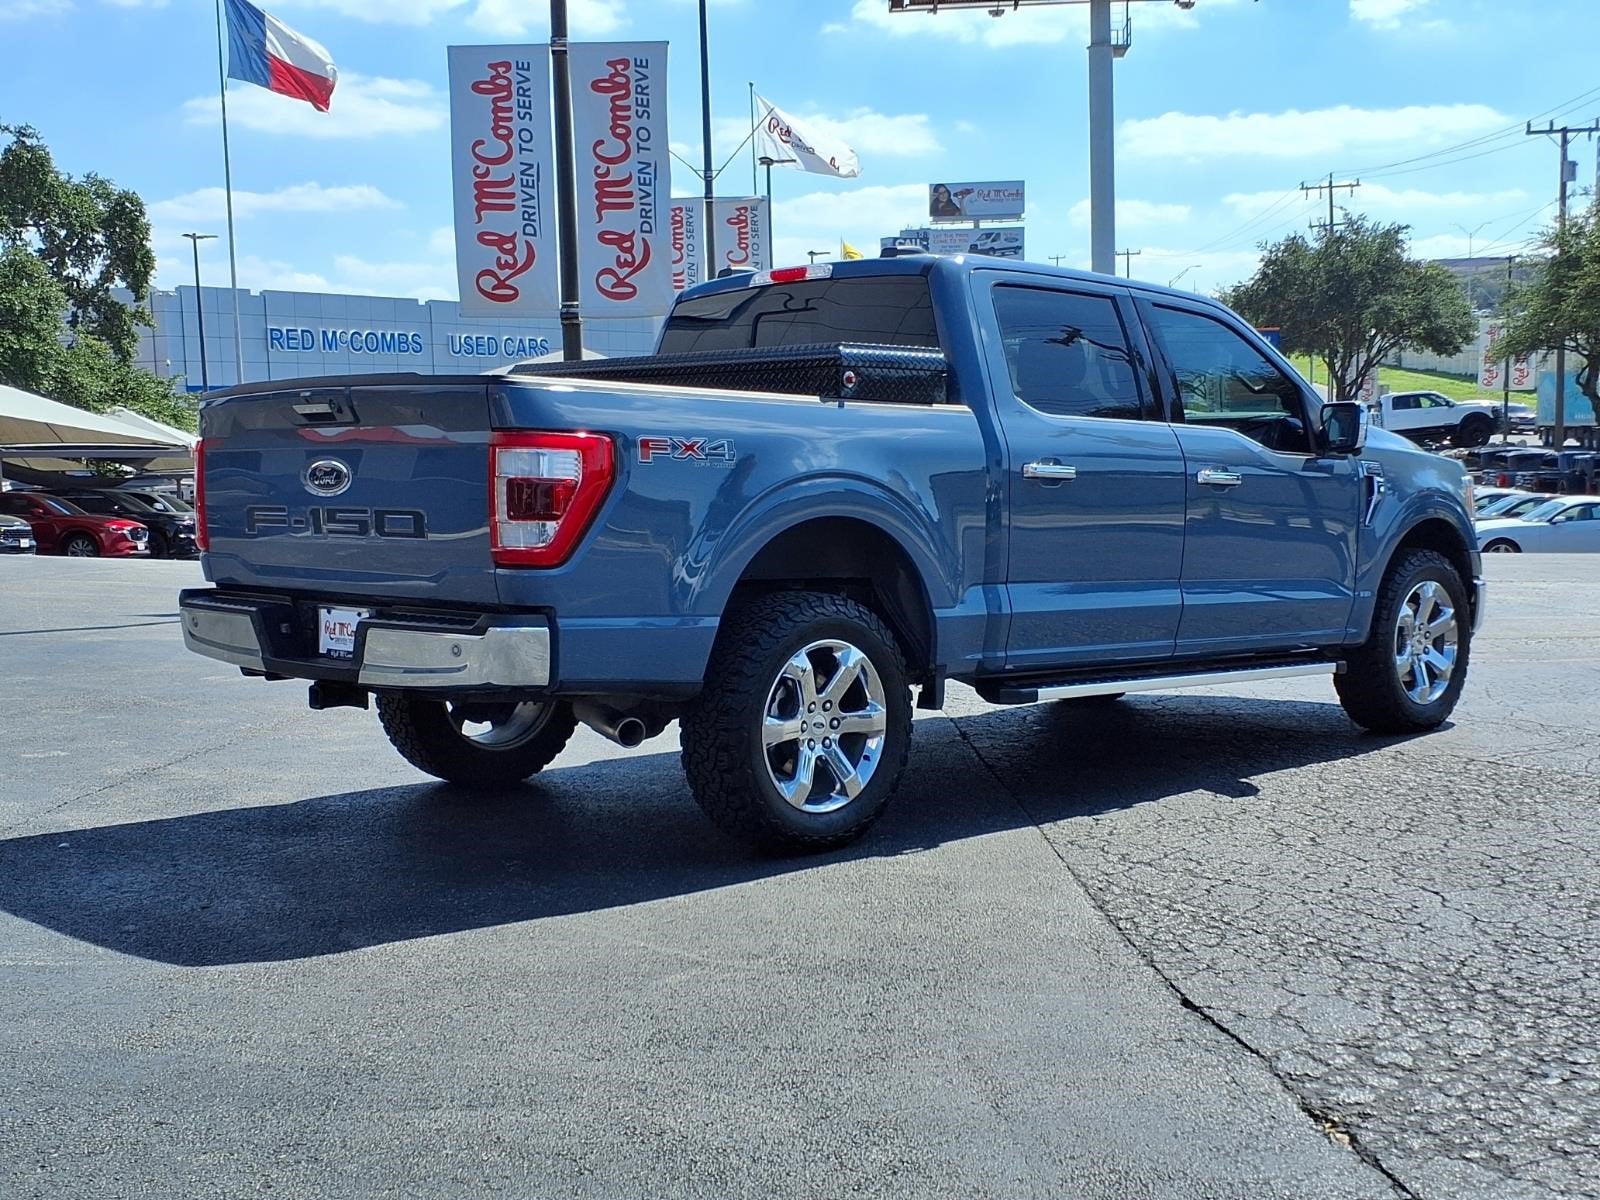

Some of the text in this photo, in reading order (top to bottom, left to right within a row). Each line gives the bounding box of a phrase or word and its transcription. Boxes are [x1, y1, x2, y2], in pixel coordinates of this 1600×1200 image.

[515, 60, 541, 237] DRIVEN TO SERVE
[634, 57, 657, 235] DRIVEN TO SERVE
[471, 61, 535, 303] Red McCombs
[590, 57, 651, 301] Red McCombs
[685, 206, 695, 240] SERVE
[750, 205, 759, 239] SERVE
[686, 243, 696, 258] TO
[752, 242, 760, 257] TO
[269, 327, 315, 351] RED
[450, 334, 550, 357] USED CARS
[1512, 367, 1530, 386] Red
[637, 436, 736, 464] FX4
[313, 466, 338, 486] Ford
[244, 505, 428, 540] F-150
